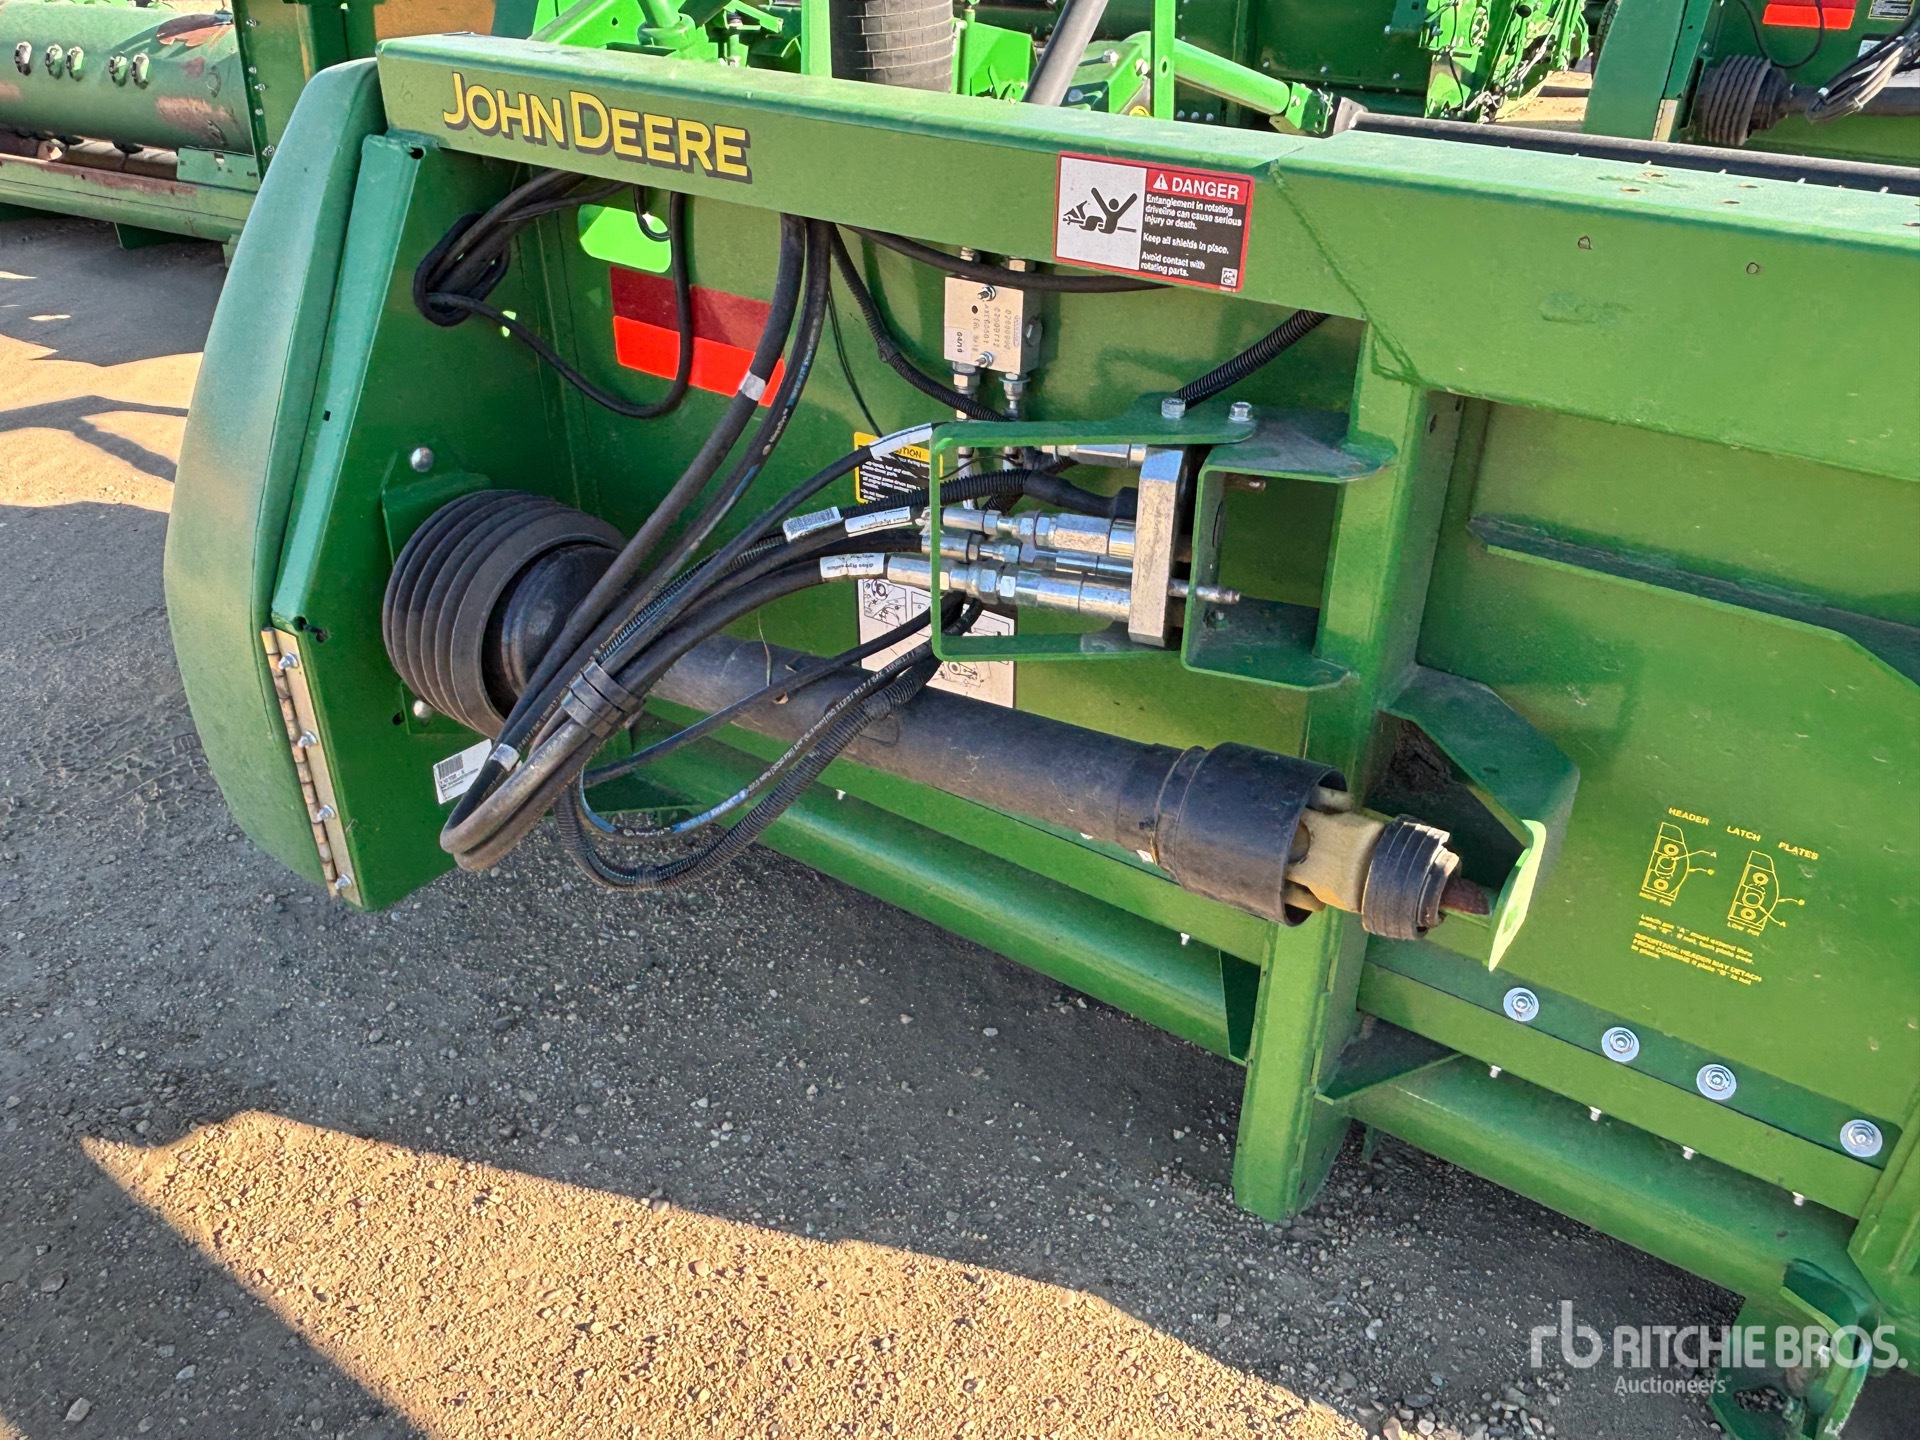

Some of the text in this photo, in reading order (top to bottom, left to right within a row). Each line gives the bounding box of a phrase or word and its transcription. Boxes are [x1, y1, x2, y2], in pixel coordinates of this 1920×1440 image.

[443, 71, 753, 184] JOHN DEERE
[1171, 176, 1240, 200] DANGER
[1145, 204, 1243, 227] driveline can cause serious
[1146, 194, 1234, 217] Entanglement in rotating
[1144, 213, 1197, 230] injury or death.
[1143, 232, 1229, 255] Keep all shields in place.
[1140, 261, 1190, 277] rotating parts.
[1141, 251, 1206, 270] Avoid contact with
[1668, 807, 1819, 861] HEADER LATCH PLATES
